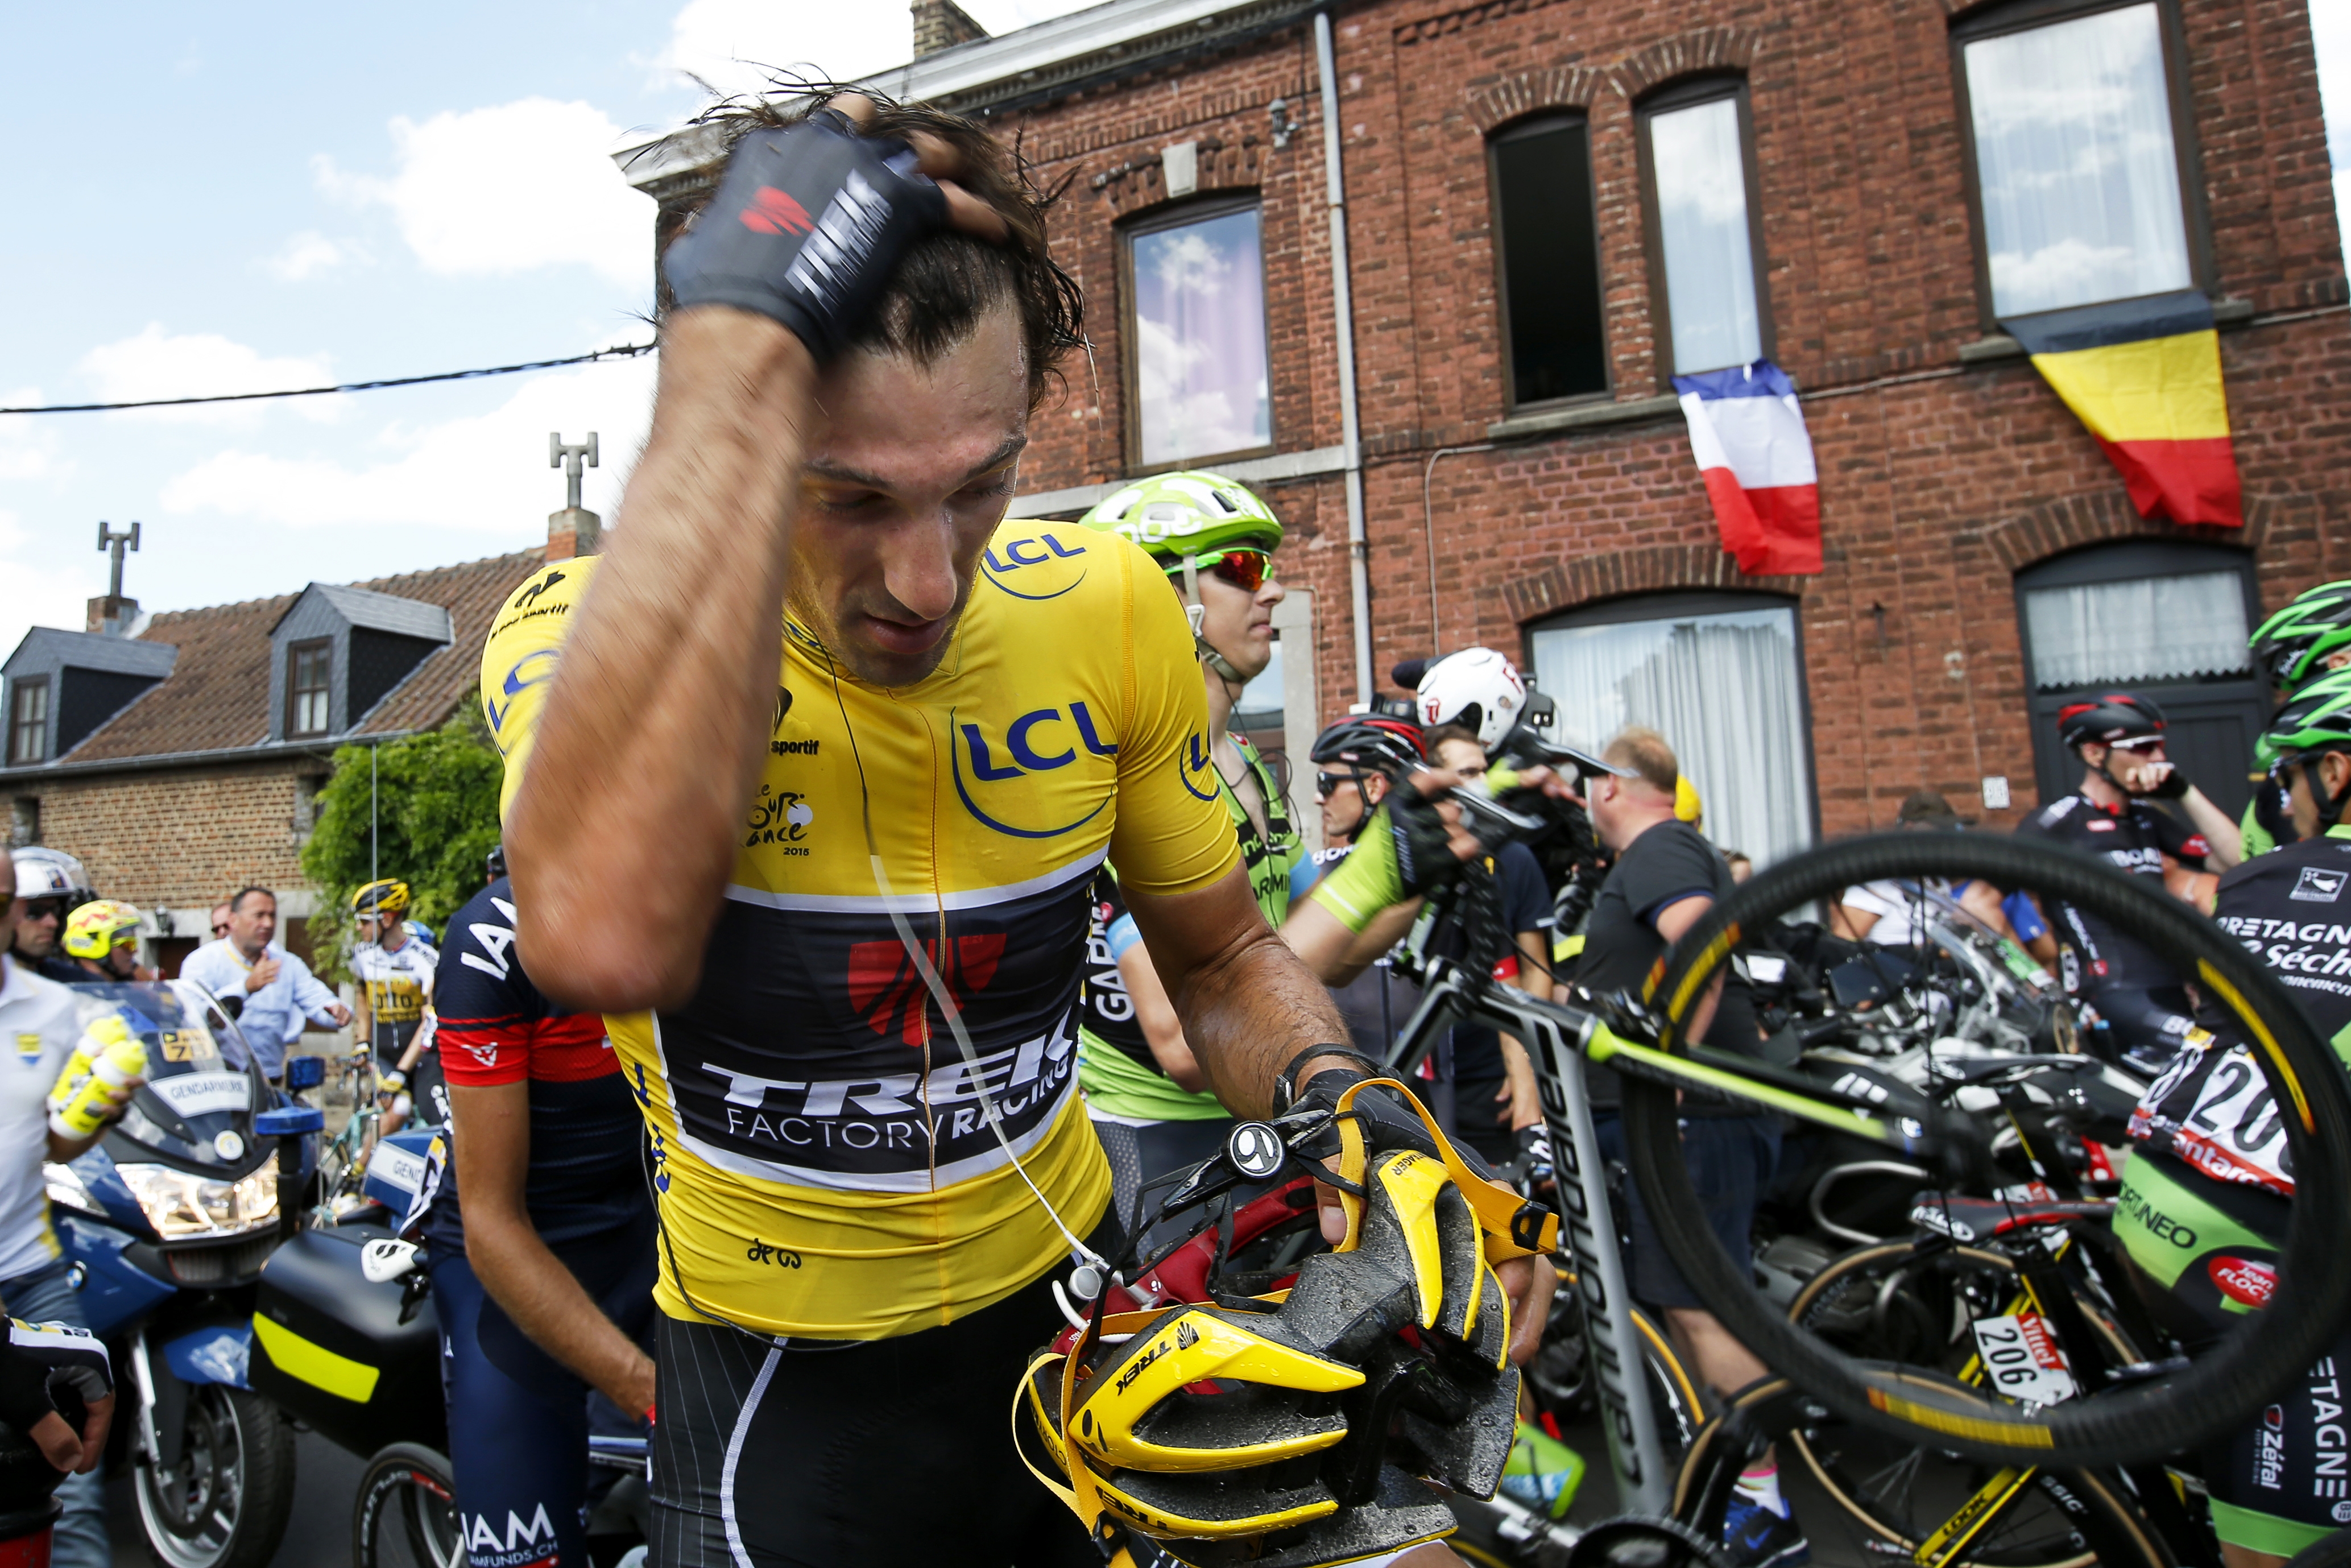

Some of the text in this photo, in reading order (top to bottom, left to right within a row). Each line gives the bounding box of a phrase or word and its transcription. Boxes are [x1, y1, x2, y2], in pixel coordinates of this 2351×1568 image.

[983, 533, 1086, 572] LCL
[771, 739, 819, 756] sportif
[961, 701, 1119, 782] LCL
[745, 822, 808, 847] ance
[783, 846, 810, 857] 2015
[1253, 873, 1289, 901] ARMI
[2215, 916, 2351, 945] BRETAGN
[1090, 905, 1136, 1022] GARM
[2265, 944, 2351, 978] Séch
[701, 1007, 1078, 1116] TREK
[171, 1080, 245, 1101] GENDARMERIE
[726, 1050, 1069, 1149] FACTORY RACING
[2237, 1267, 2275, 1289] Jean
[1979, 1327, 2038, 1385] 206
[2022, 1316, 2058, 1364] Vittel
[1115, 1340, 1172, 1396] TREK
[2308, 1355, 2348, 1499] ETAGNE
[2260, 1430, 2286, 1490] Zéfal
[461, 1501, 556, 1553] IAM
